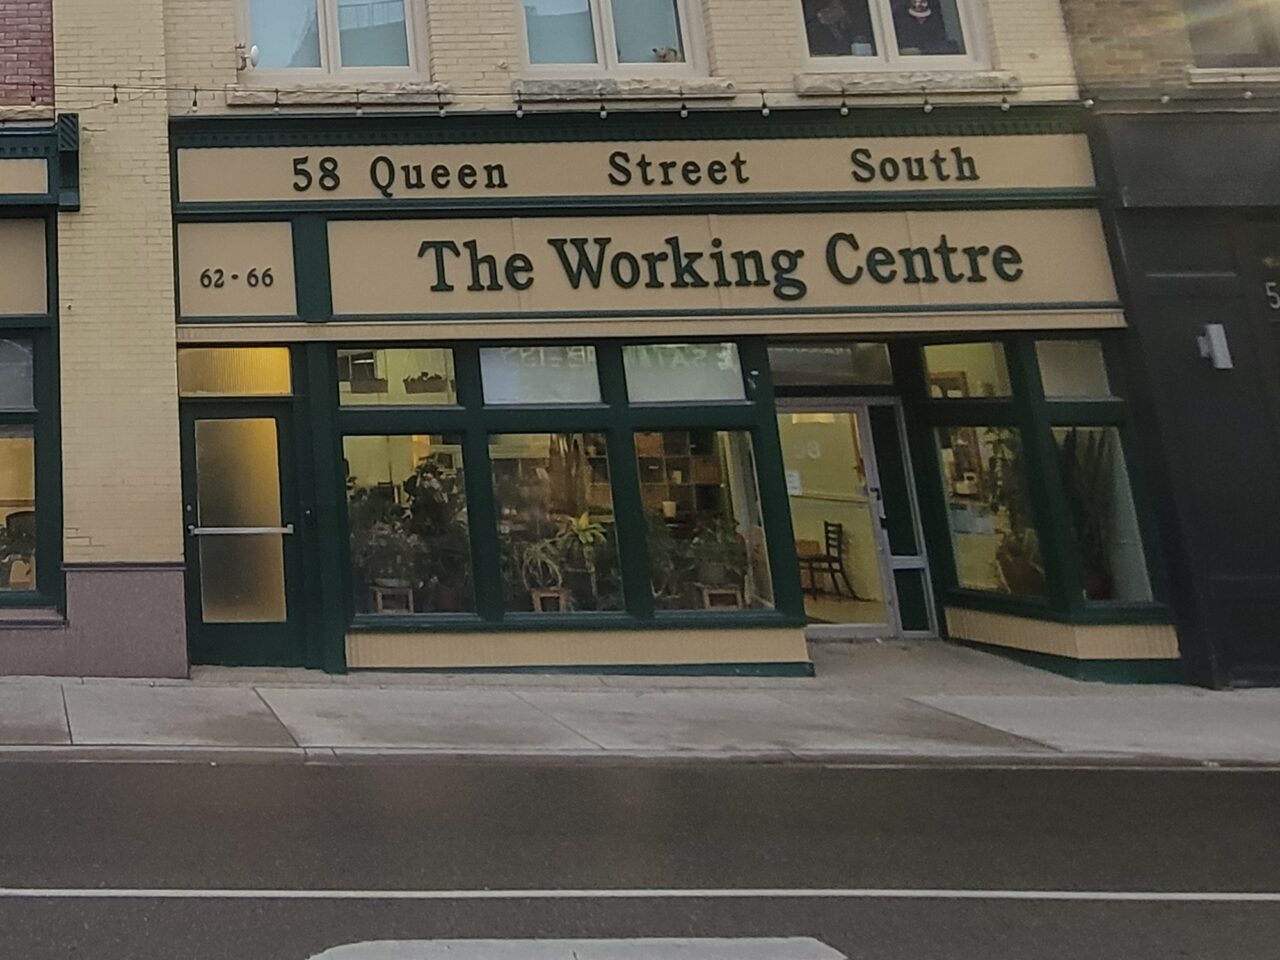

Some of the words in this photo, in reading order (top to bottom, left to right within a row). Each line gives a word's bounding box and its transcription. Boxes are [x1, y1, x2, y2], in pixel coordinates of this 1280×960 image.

[293, 156, 340, 192] 58
[369, 155, 509, 198] Queen
[608, 151, 749, 186] Street
[851, 147, 980, 183] South
[418, 239, 534, 292] The
[547, 236, 807, 300] Working
[826, 233, 1023, 285] Centre
